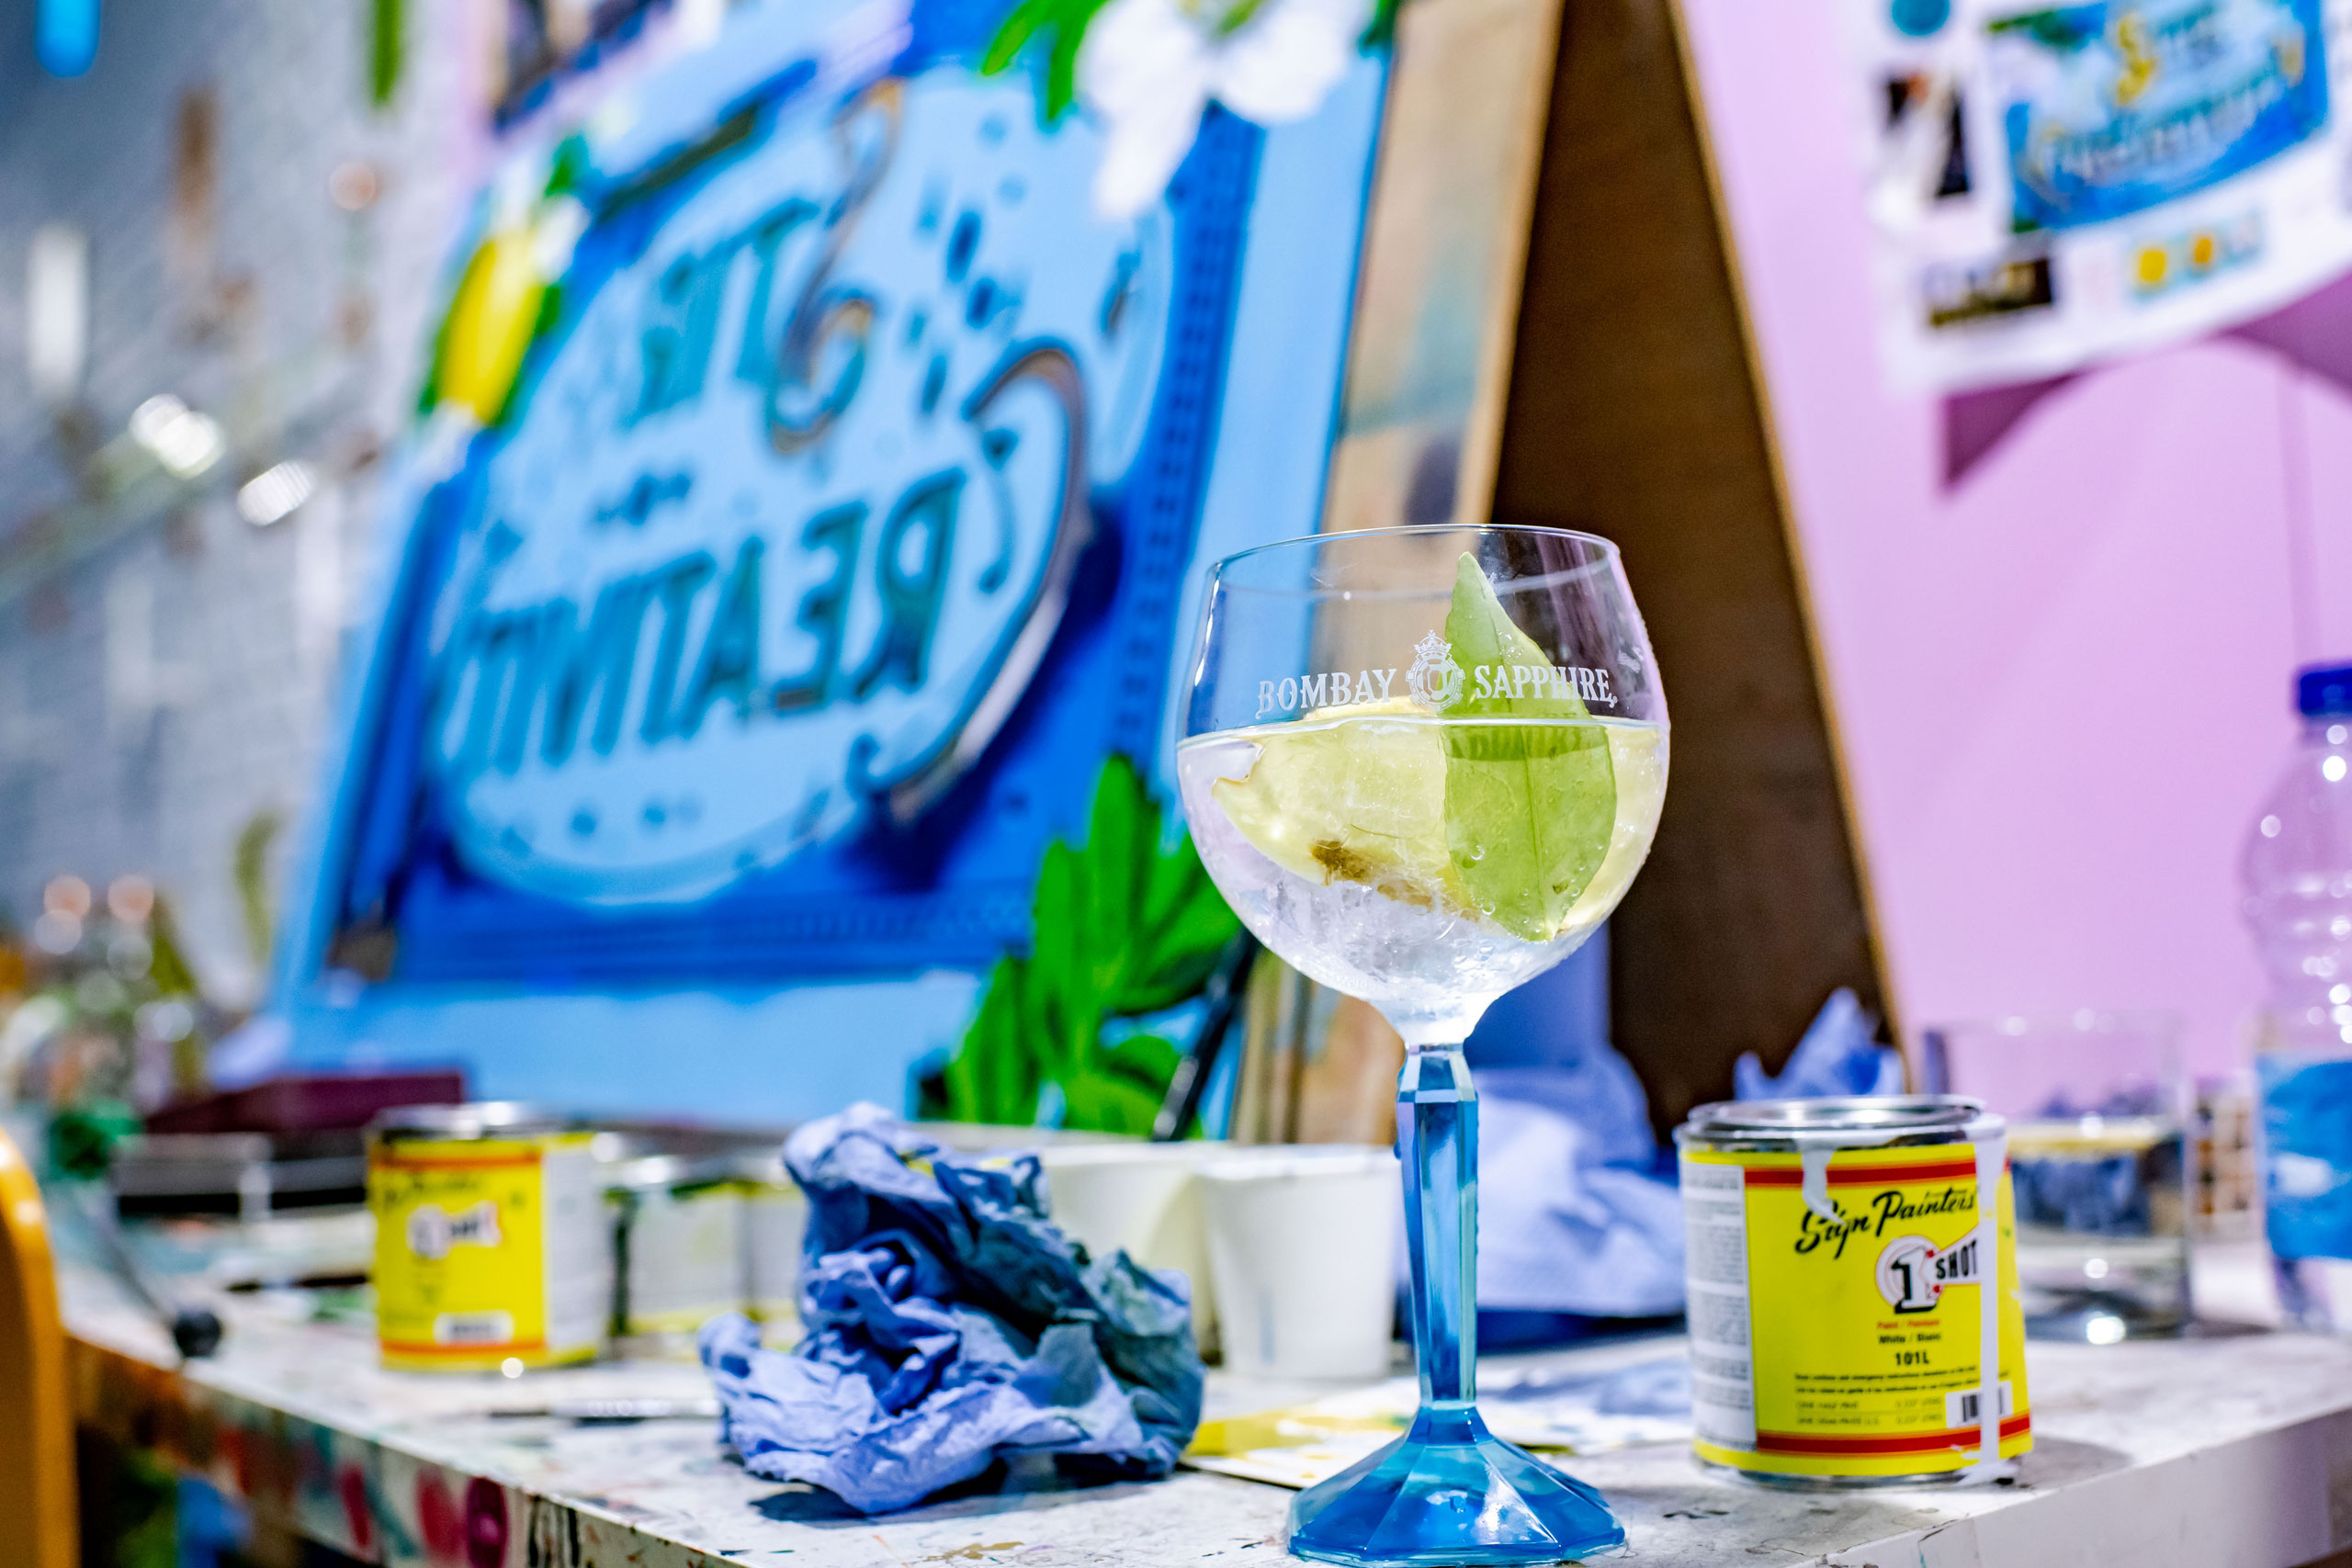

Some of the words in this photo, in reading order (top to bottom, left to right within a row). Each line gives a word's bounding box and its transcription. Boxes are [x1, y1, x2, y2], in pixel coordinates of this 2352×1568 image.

[1255, 668, 1396, 719] BOMBAY
[1475, 664, 1617, 709] SAPPHIRE
[1936, 1239, 1978, 1280] SHOT
[1895, 1349, 1929, 1366] 101L
